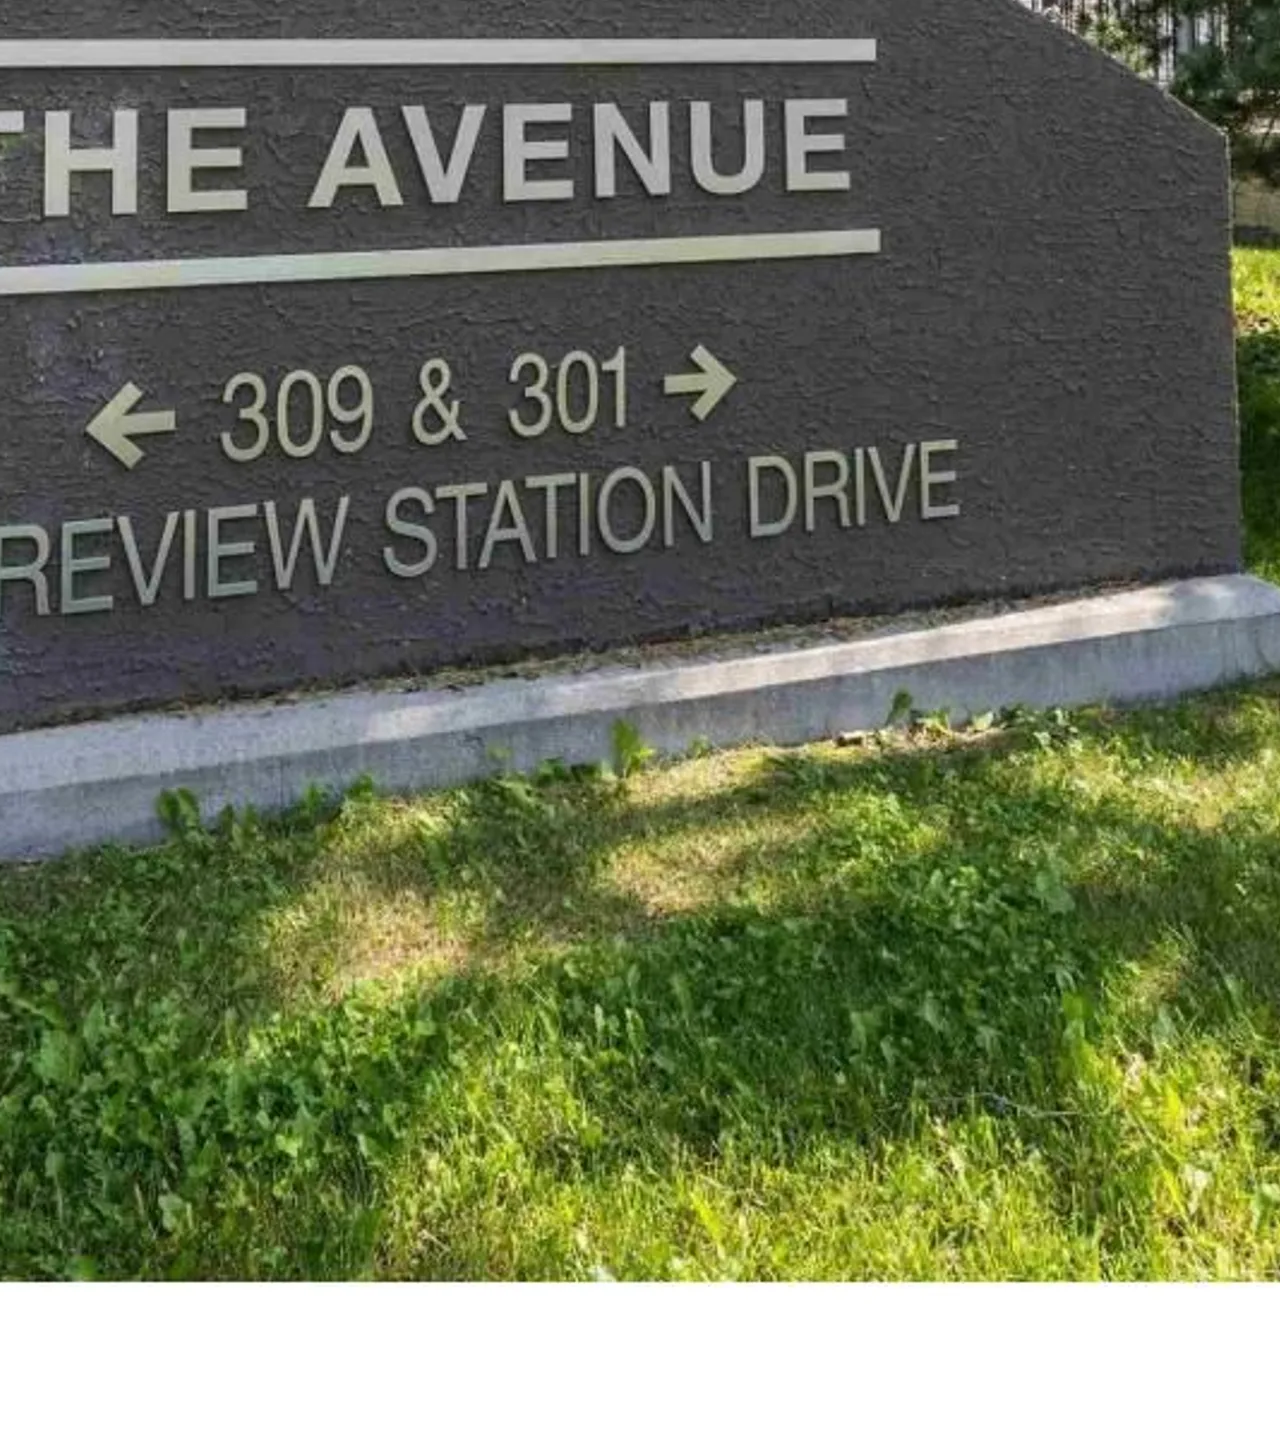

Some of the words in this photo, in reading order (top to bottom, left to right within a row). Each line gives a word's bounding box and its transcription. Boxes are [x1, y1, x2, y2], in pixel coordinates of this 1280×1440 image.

[307, 97, 852, 208] AVENUE
[219, 364, 374, 461] 309
[411, 357, 468, 445] &
[507, 345, 627, 437] 301
[383, 461, 713, 577] STATION
[748, 438, 960, 537] DRIVE
